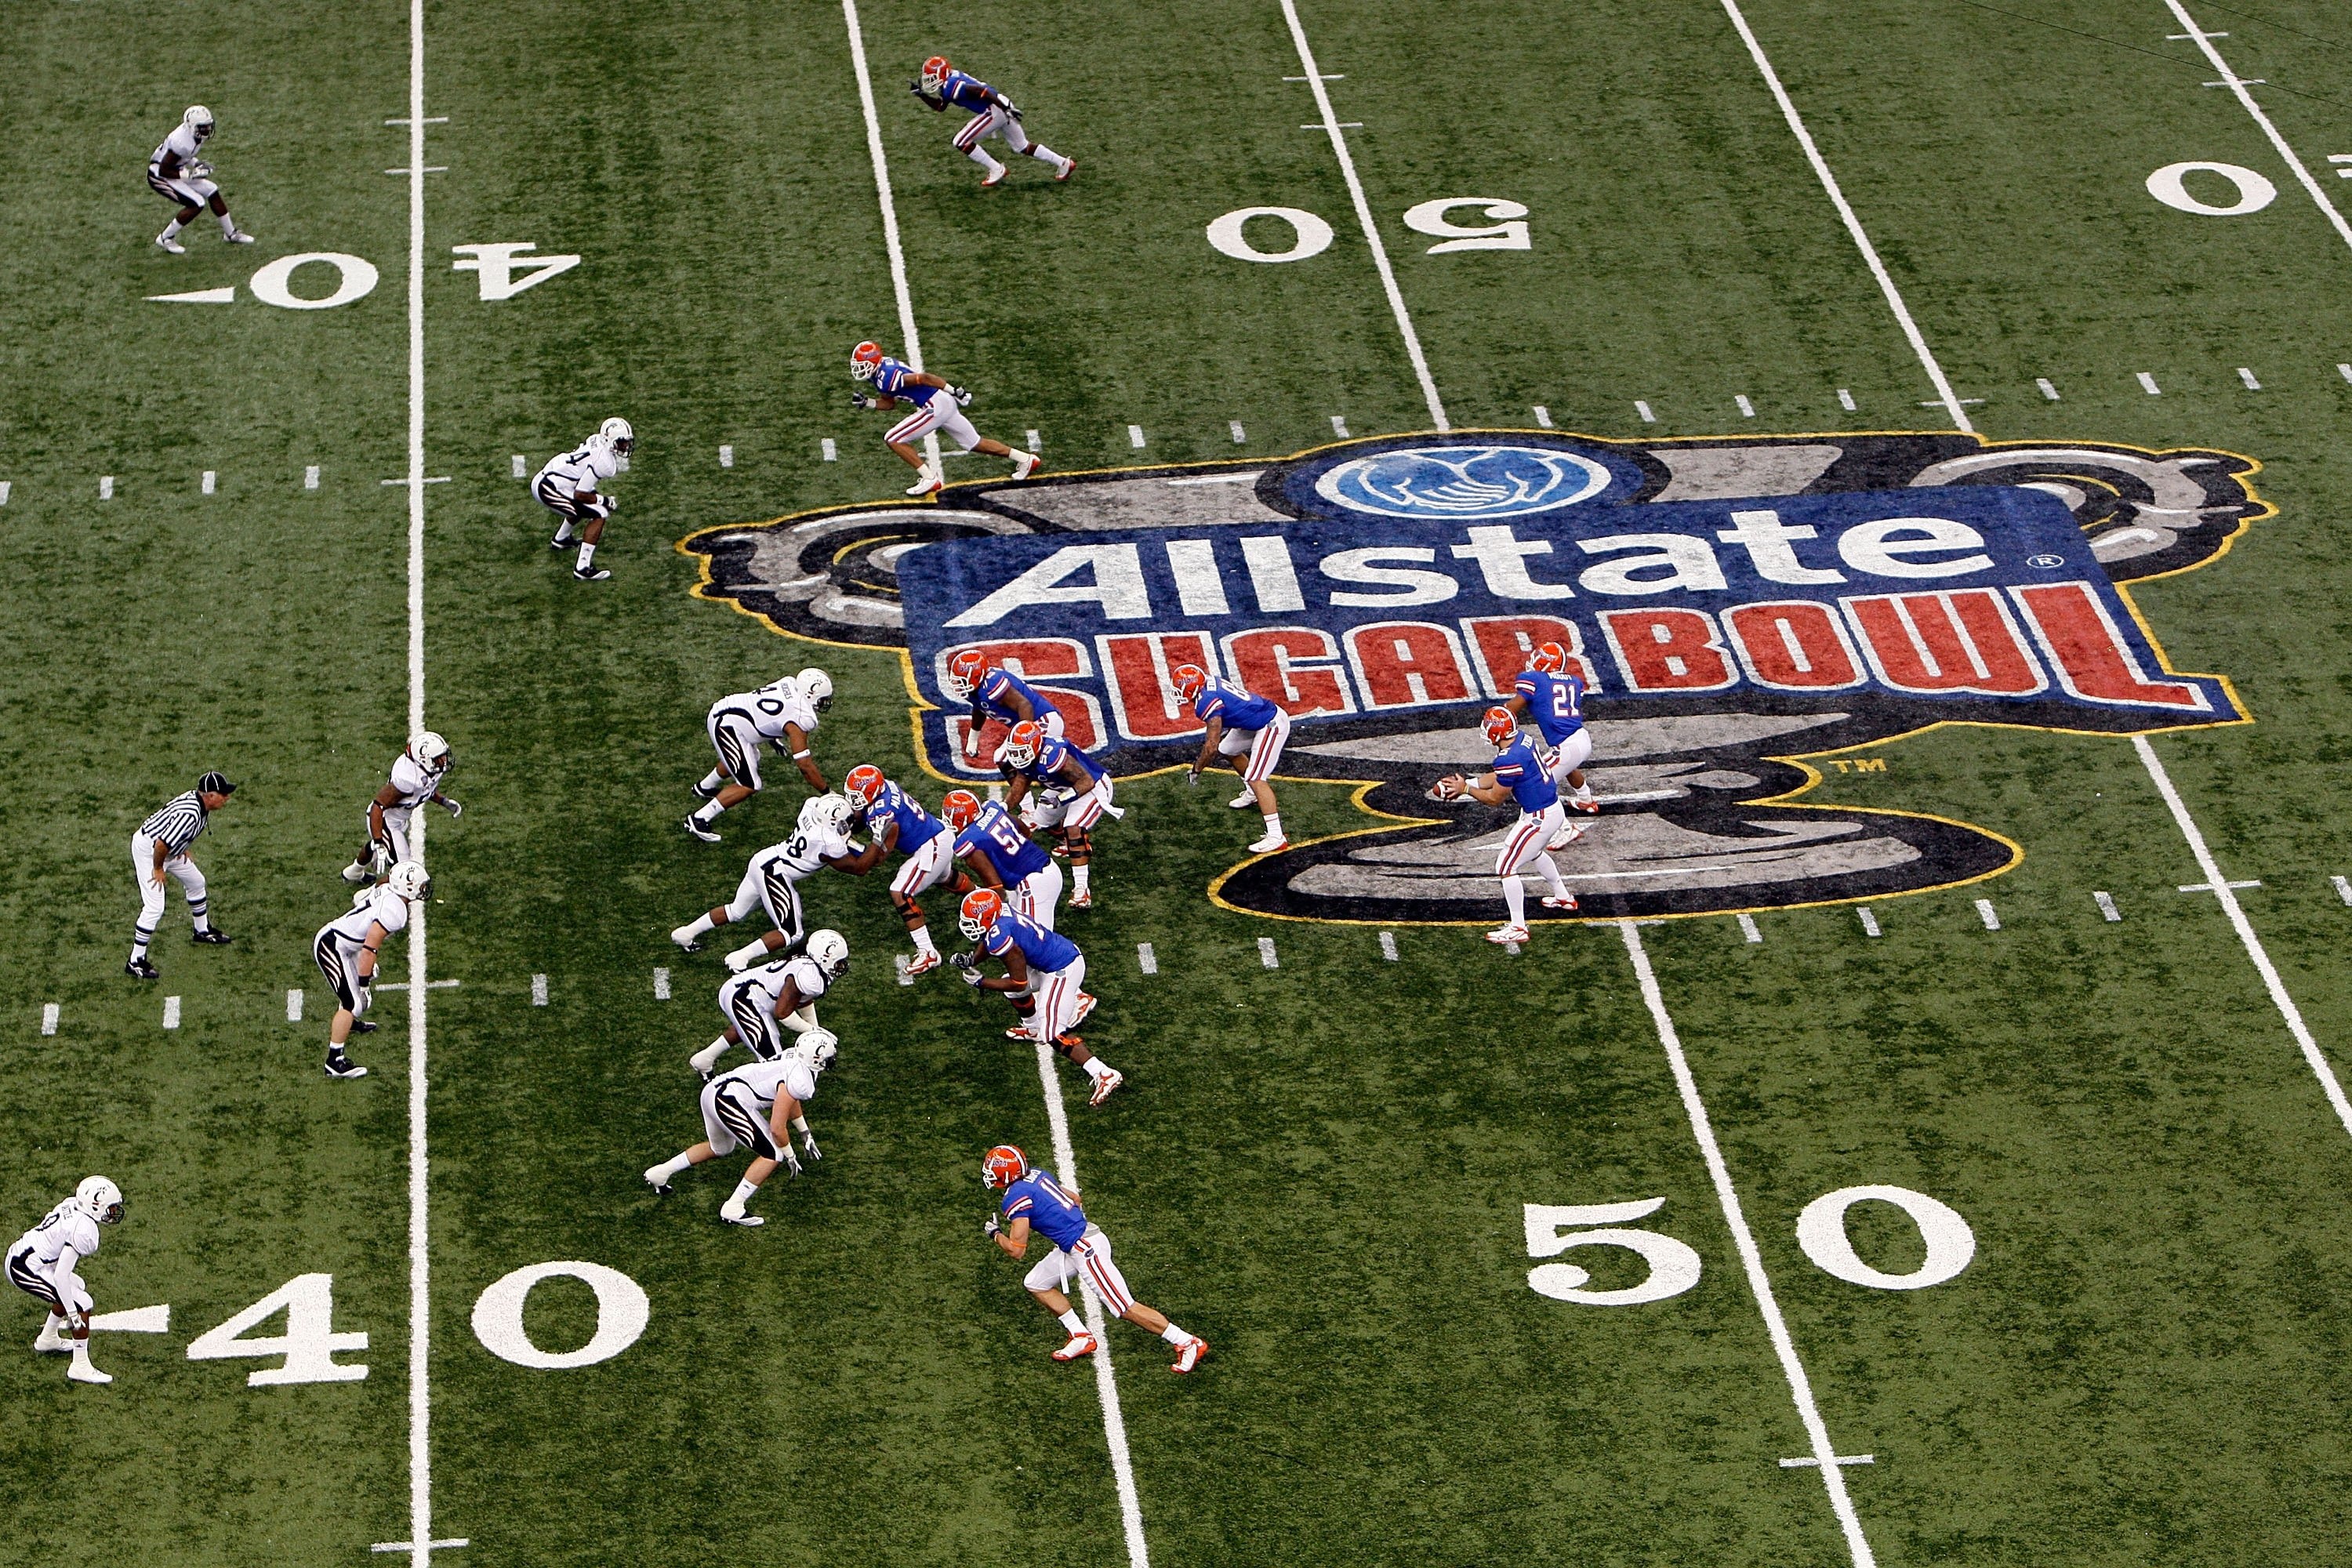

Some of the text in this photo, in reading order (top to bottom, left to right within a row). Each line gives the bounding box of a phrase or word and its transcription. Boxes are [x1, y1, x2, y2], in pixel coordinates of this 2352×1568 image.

[943, 510, 1995, 627] Allstate
[935, 580, 2213, 773] SUGAR BOWL
[752, 687, 784, 716] 40
[1552, 683, 1579, 716] 21
[1828, 757, 1888, 773] TM
[989, 815, 1026, 855] 57
[1039, 1177, 1075, 1211] 11
